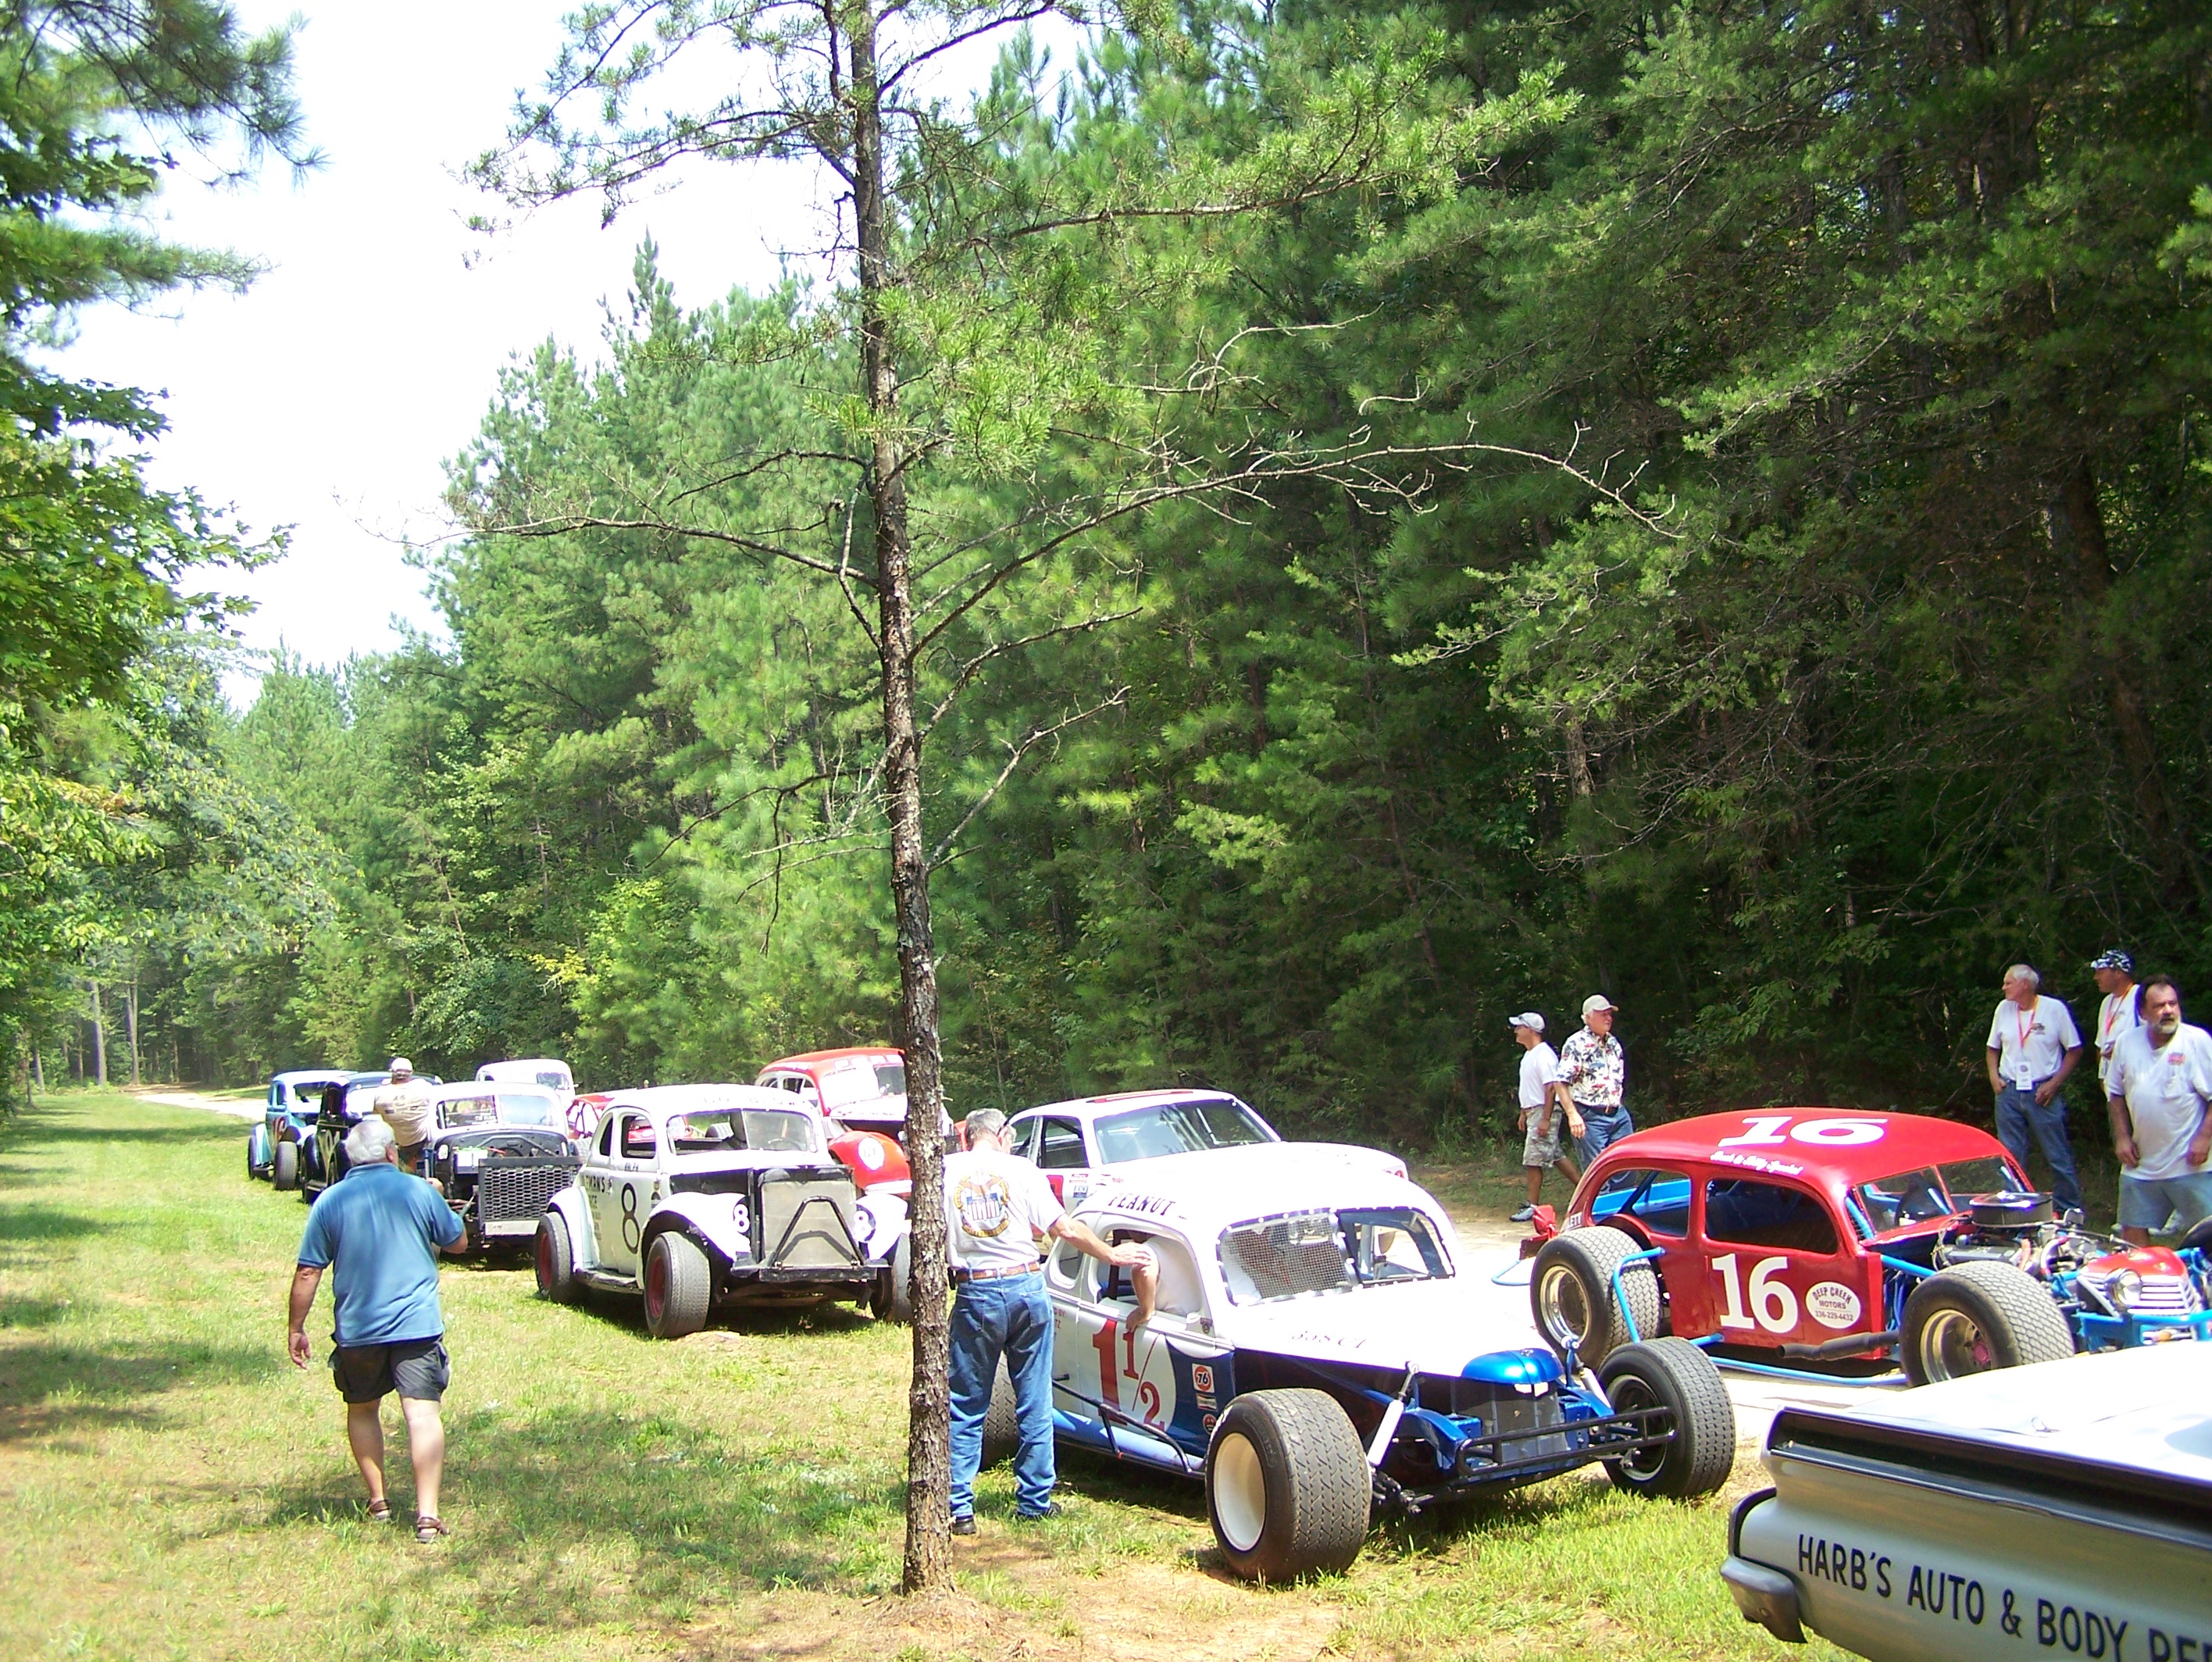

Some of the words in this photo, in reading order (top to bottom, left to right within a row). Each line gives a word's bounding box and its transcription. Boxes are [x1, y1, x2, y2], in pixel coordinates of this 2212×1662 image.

[1718, 1116, 1888, 1147] 16
[621, 1182, 640, 1254] 8
[733, 1204, 750, 1233] 8
[853, 1210, 872, 1243] 8
[1711, 1253, 1798, 1333] 16
[1812, 1286, 1828, 1301] DEEP
[1829, 1286, 1853, 1304] CREEK
[1818, 1300, 1846, 1310] MOTORS
[1197, 1372, 1208, 1385] 76
[1798, 1533, 1892, 1598] HARB'S
[1907, 1564, 1985, 1625] AUTO
[2000, 1587, 2023, 1639] &
[2036, 1597, 2128, 1662] BODY
